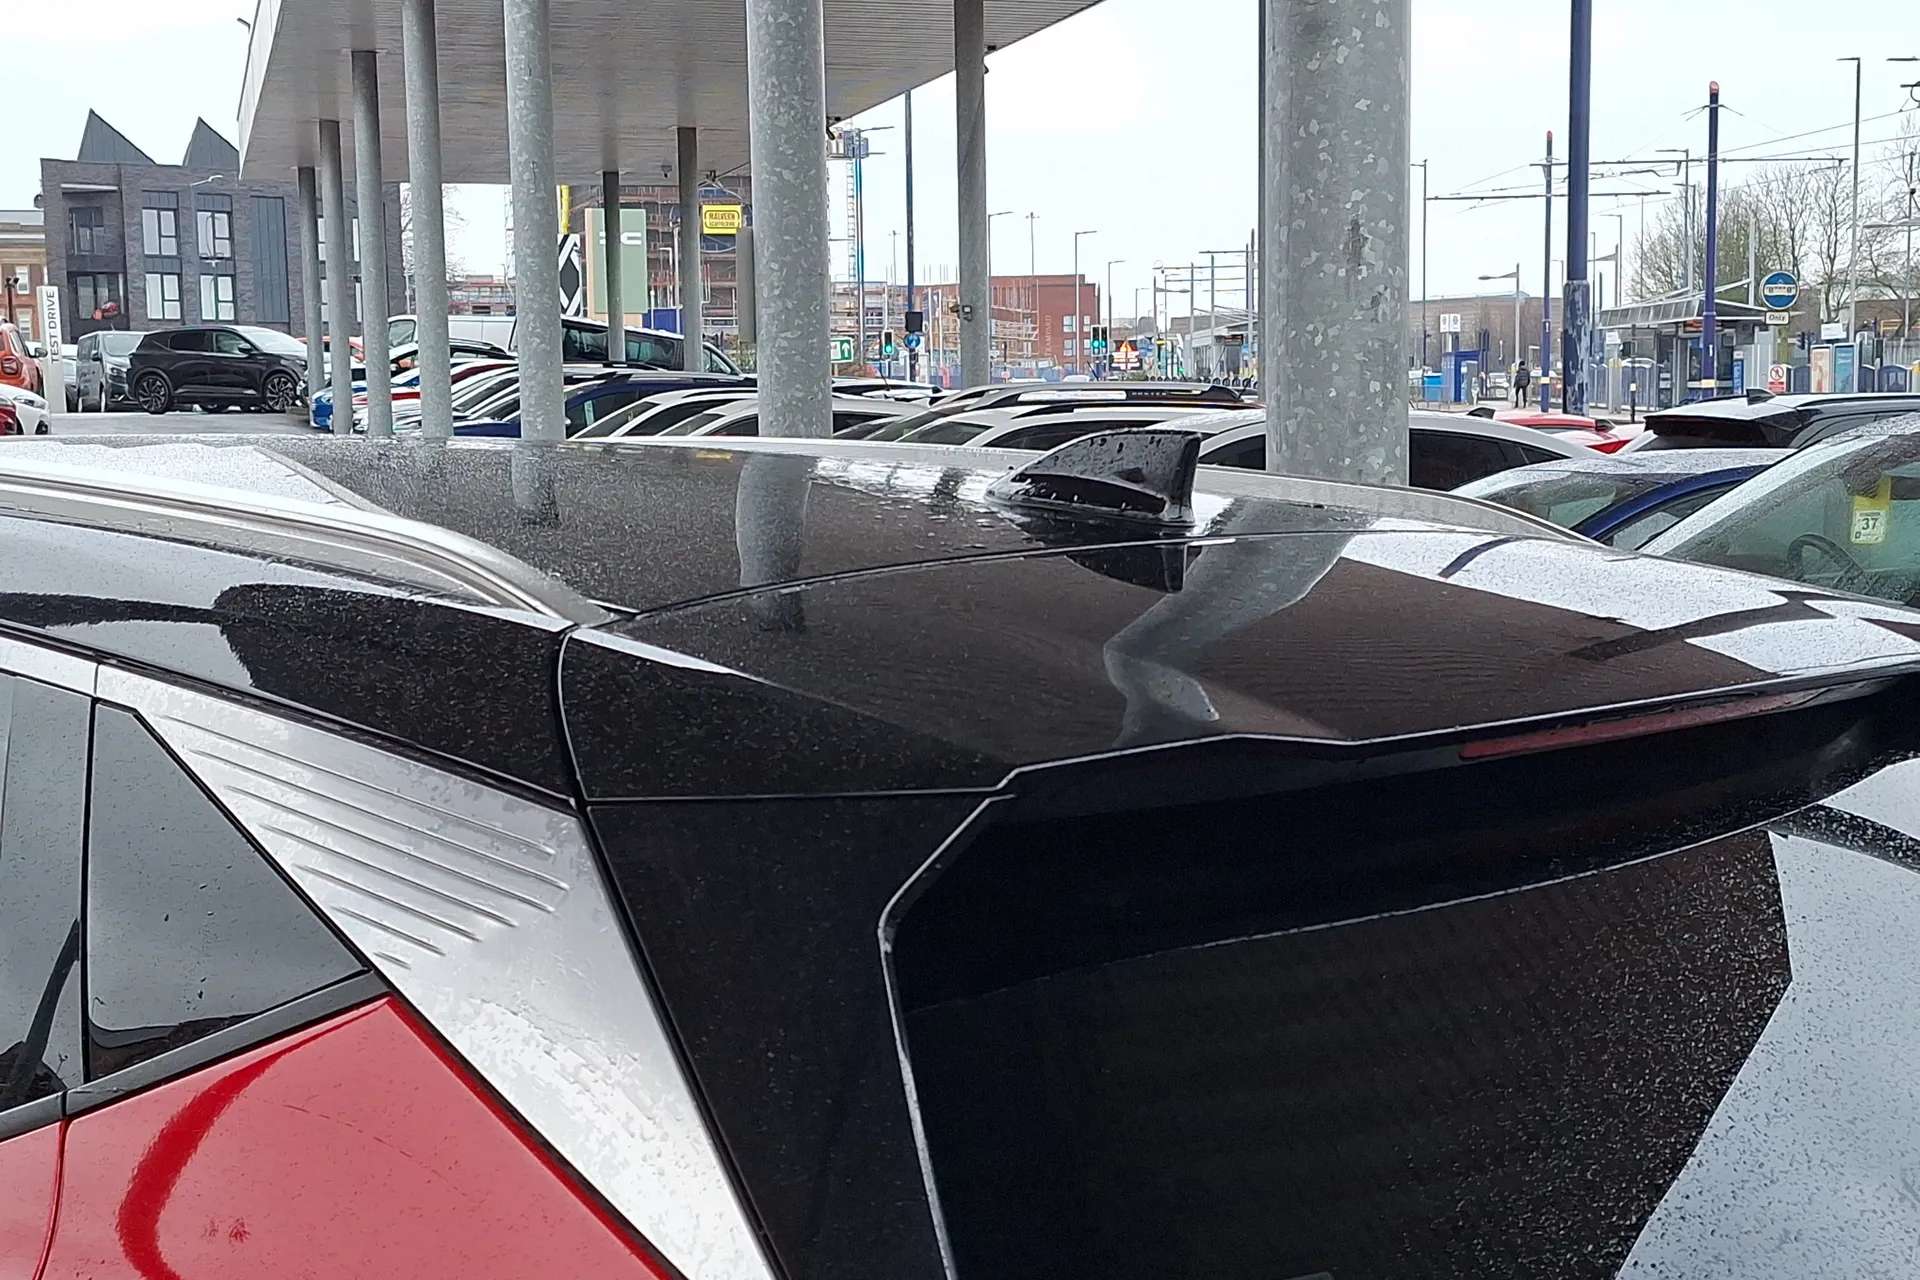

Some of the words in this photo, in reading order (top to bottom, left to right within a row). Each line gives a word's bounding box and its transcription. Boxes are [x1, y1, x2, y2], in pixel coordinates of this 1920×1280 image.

[46, 290, 57, 329] DRIVE
[1769, 314, 1786, 322] Only
[49, 333, 60, 364] TEST
[1861, 517, 1879, 530] 37
